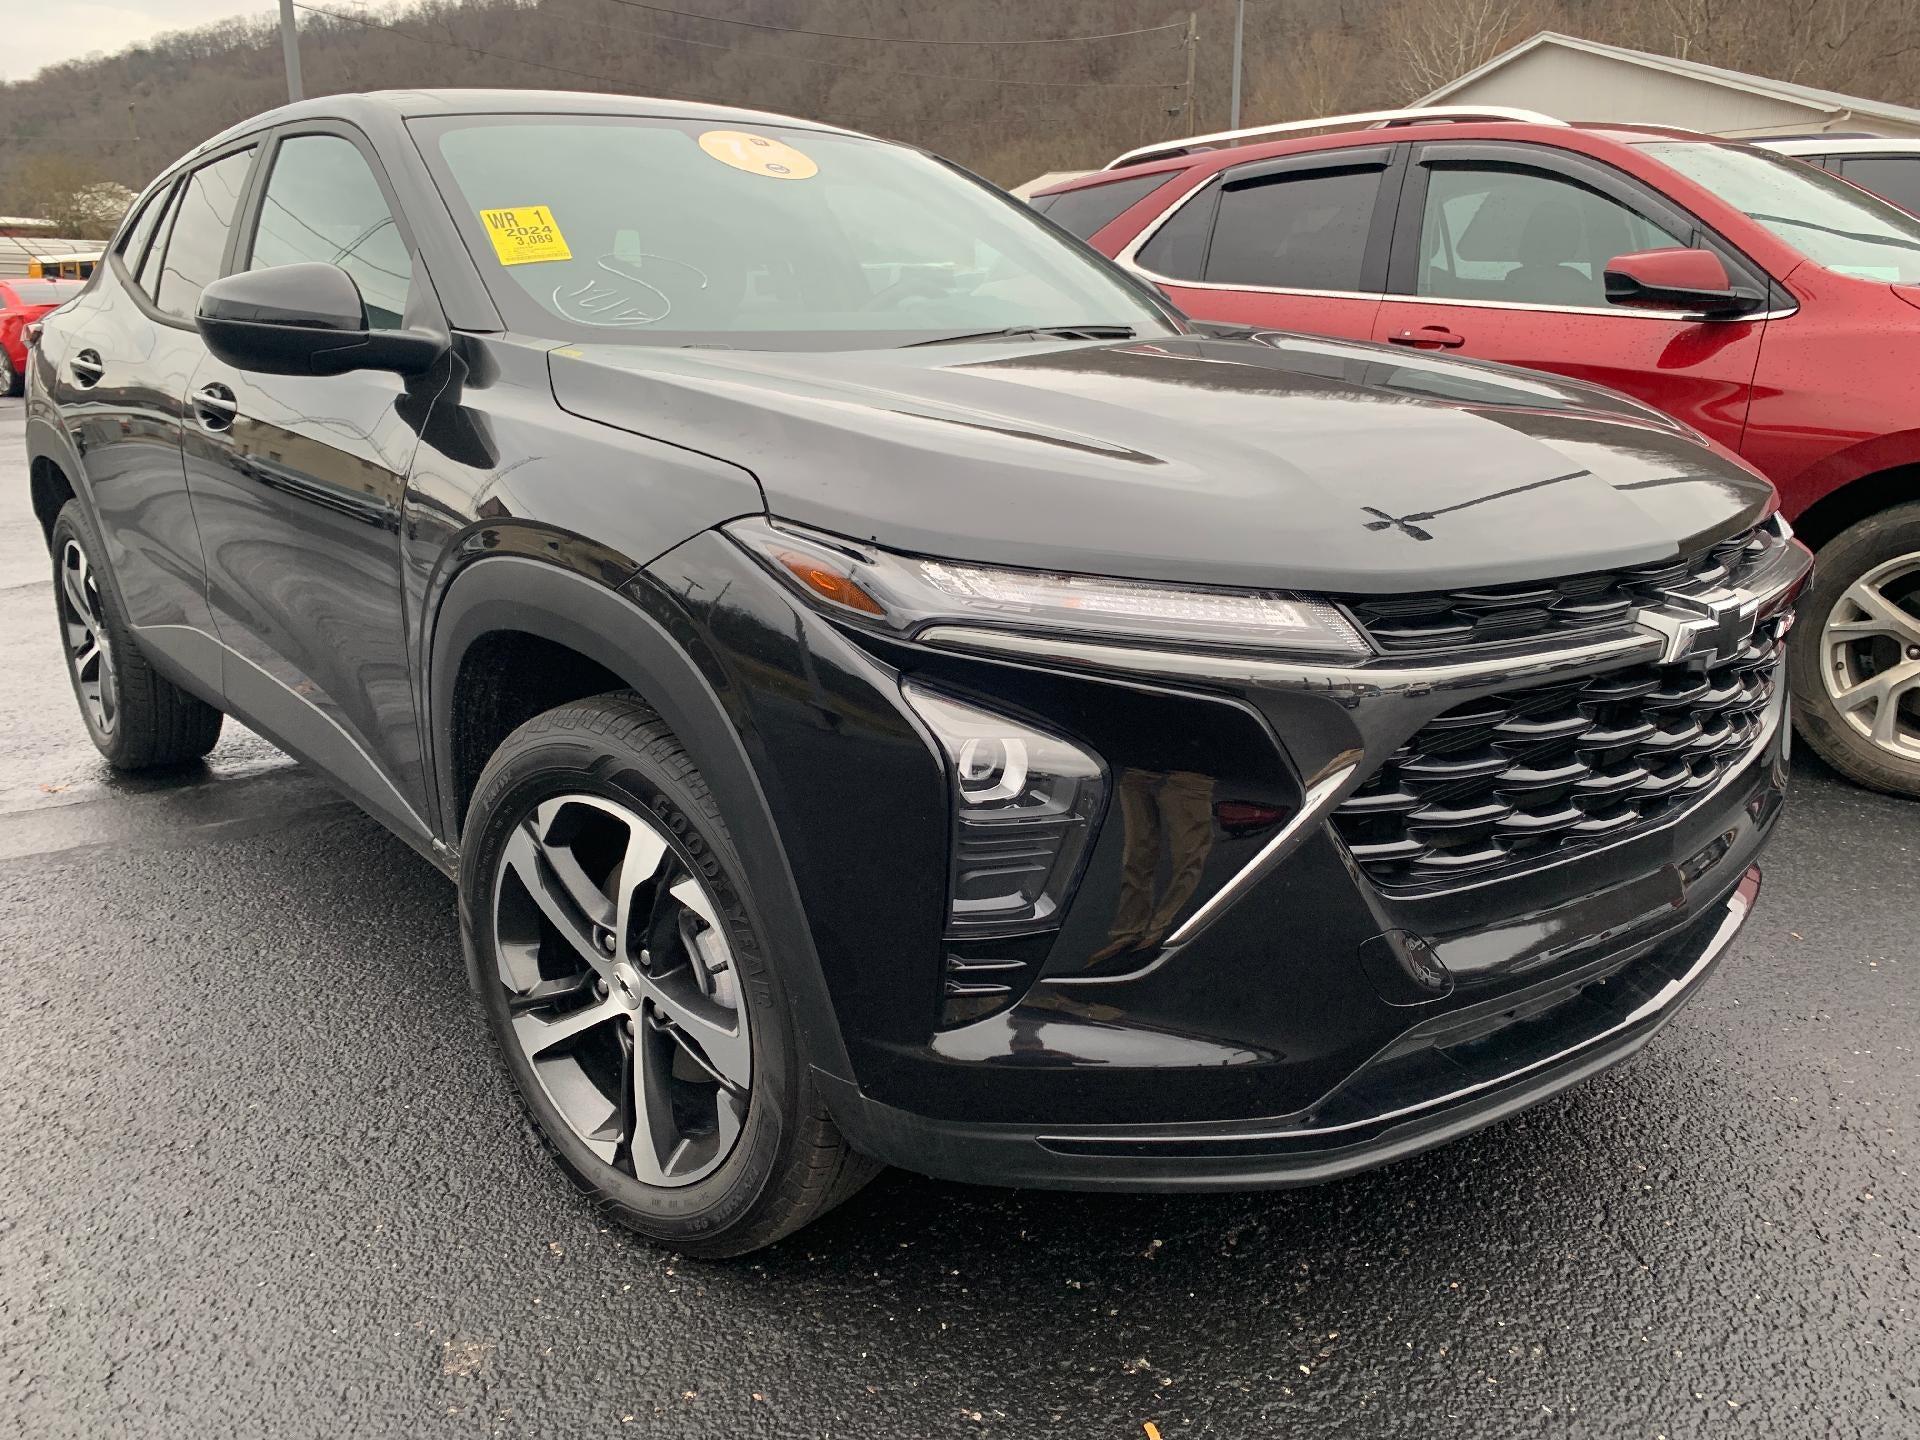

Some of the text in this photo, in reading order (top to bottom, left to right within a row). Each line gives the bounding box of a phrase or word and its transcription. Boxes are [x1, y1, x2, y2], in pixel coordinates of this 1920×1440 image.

[487, 209, 545, 230] WR 1
[504, 225, 553, 237] 2024
